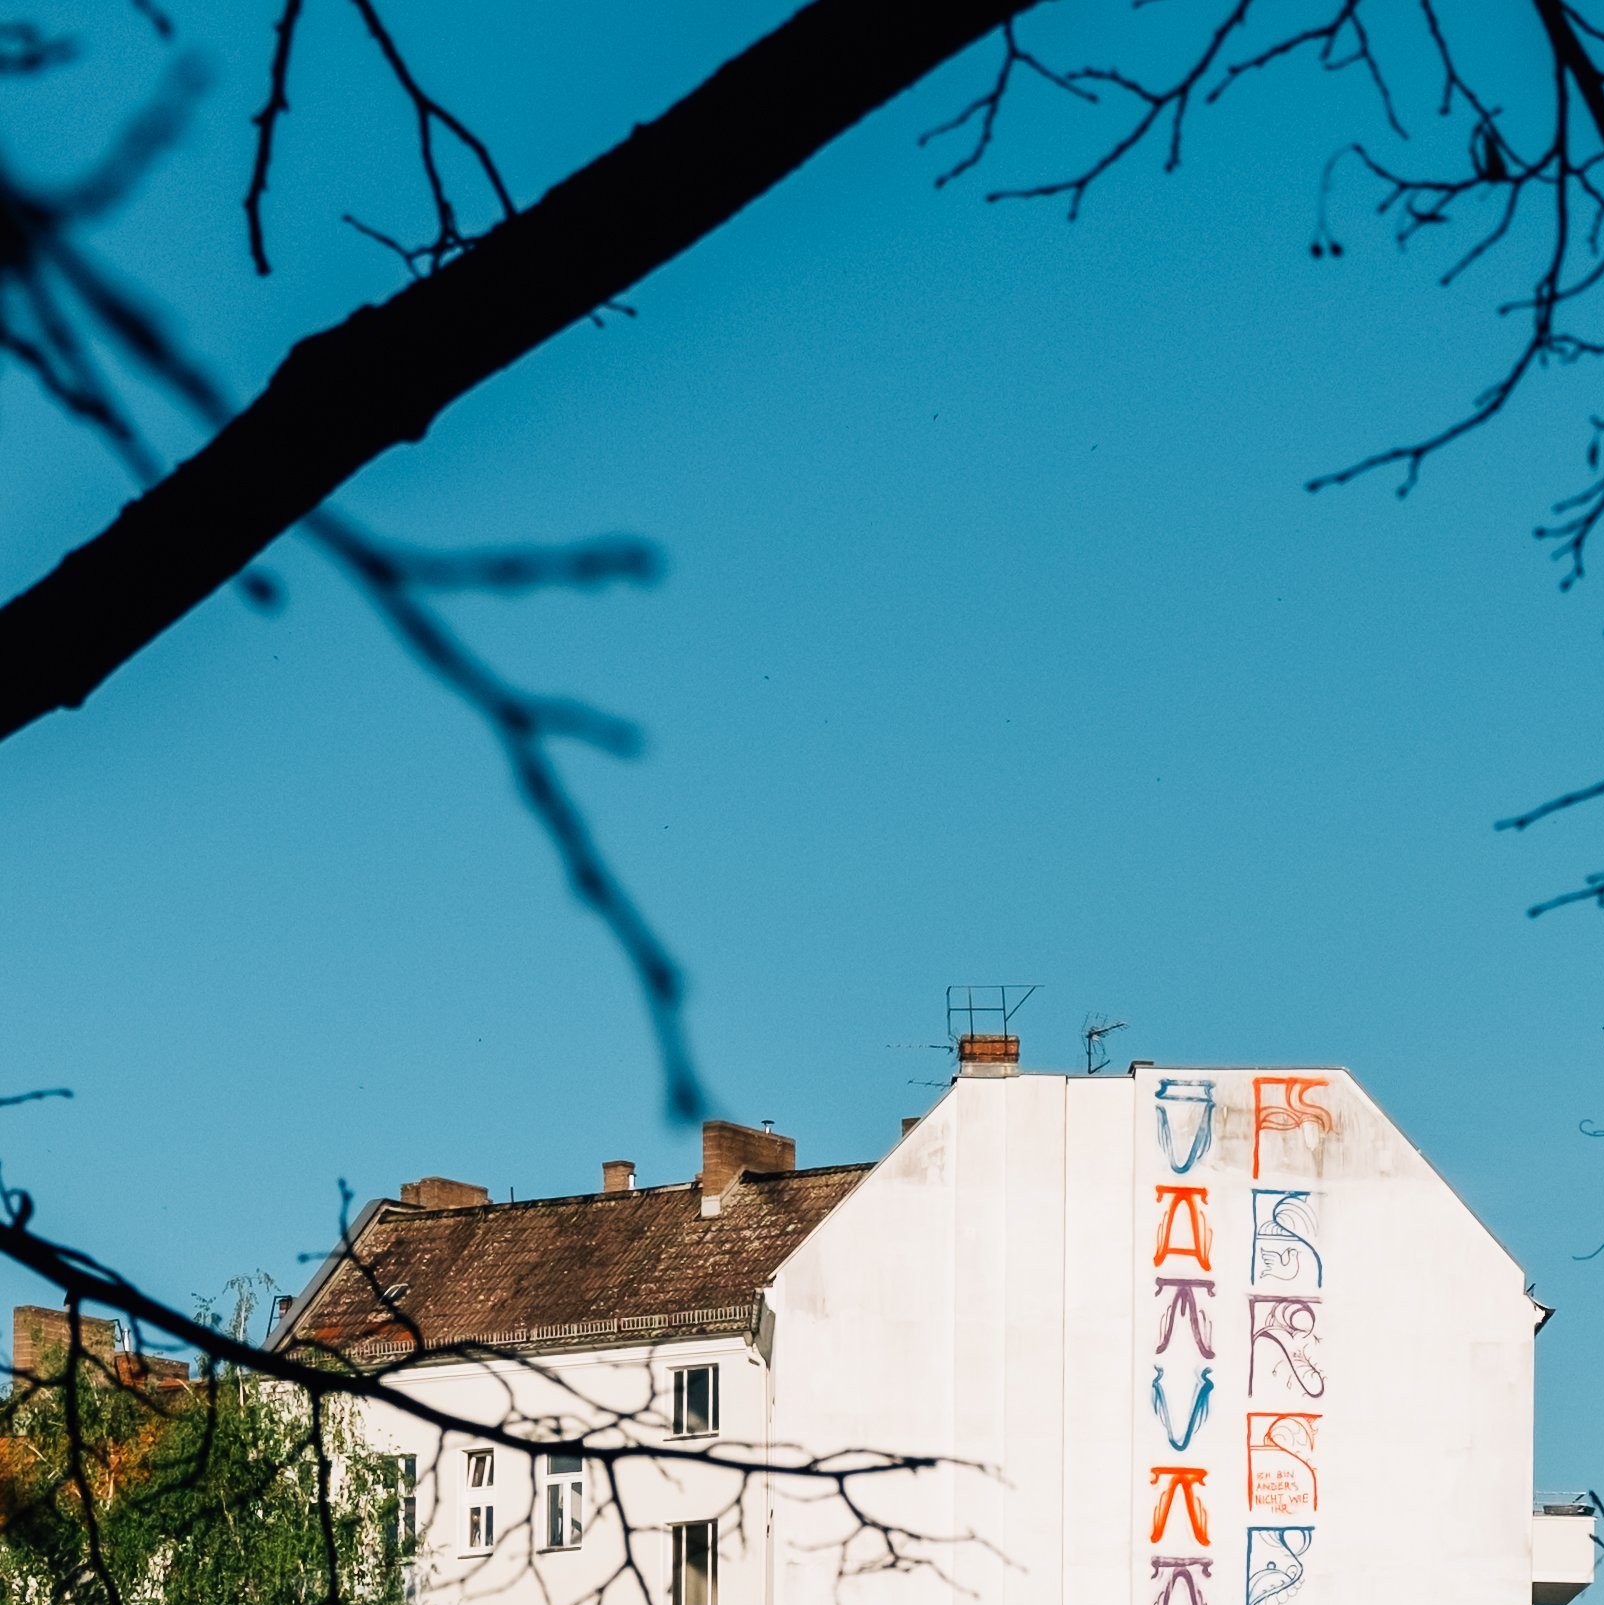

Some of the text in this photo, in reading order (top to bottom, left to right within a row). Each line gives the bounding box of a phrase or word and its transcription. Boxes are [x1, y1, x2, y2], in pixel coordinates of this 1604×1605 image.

[1276, 1470, 1295, 1480] BIN
[1256, 1481, 1299, 1491] ANDERS
[1255, 1493, 1309, 1505] NICHT WIE
[1271, 1503, 1296, 1515] IHR
